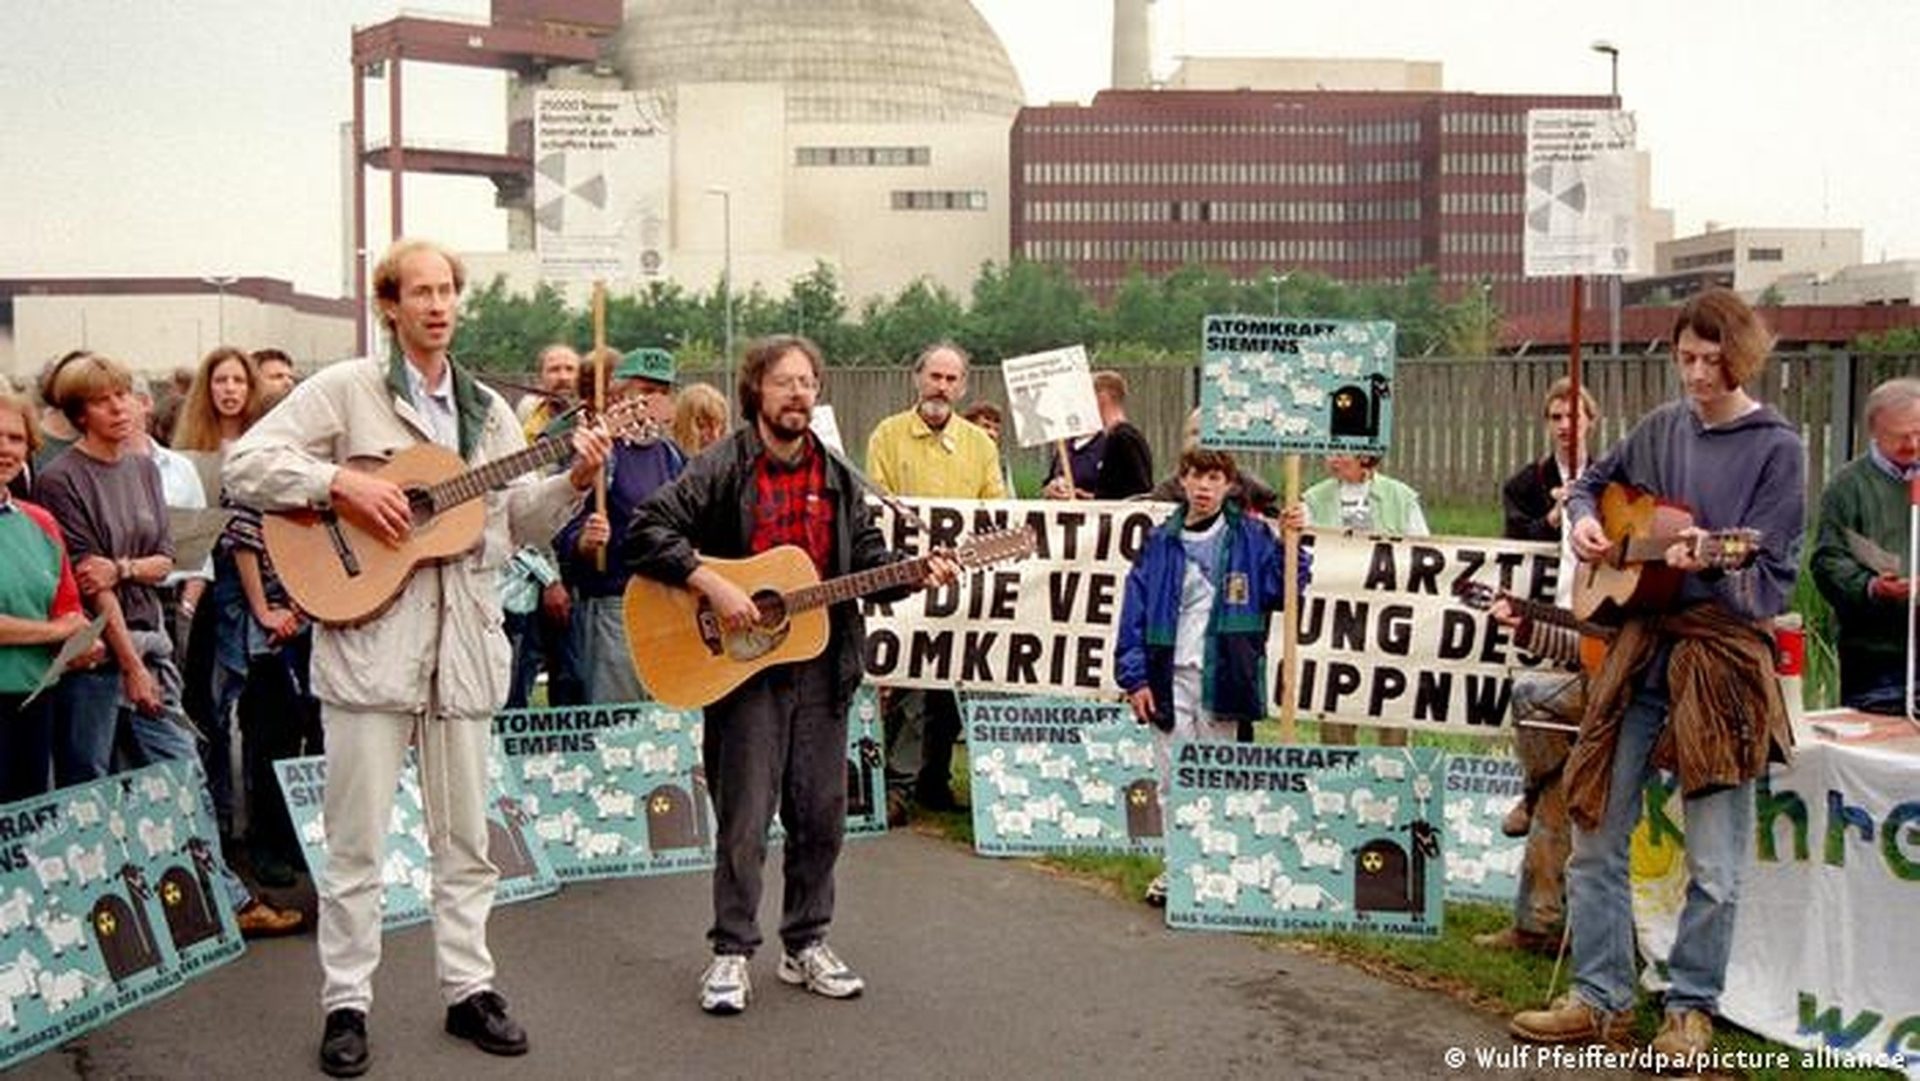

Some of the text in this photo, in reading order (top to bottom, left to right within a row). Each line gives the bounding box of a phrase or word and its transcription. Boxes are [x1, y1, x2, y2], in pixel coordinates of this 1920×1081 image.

[1207, 319, 1338, 339] ATOMKRAFT
[1207, 336, 1300, 354] SIEMENS
[1363, 534, 1560, 604] ÄRZTE
[924, 572, 1024, 620] DIE
[974, 705, 1121, 725] ATOMKRAFT
[974, 724, 1082, 744] SIEMENS
[1179, 744, 1359, 771] ATOMKRAFT
[1179, 767, 1308, 793] SIEMENS
